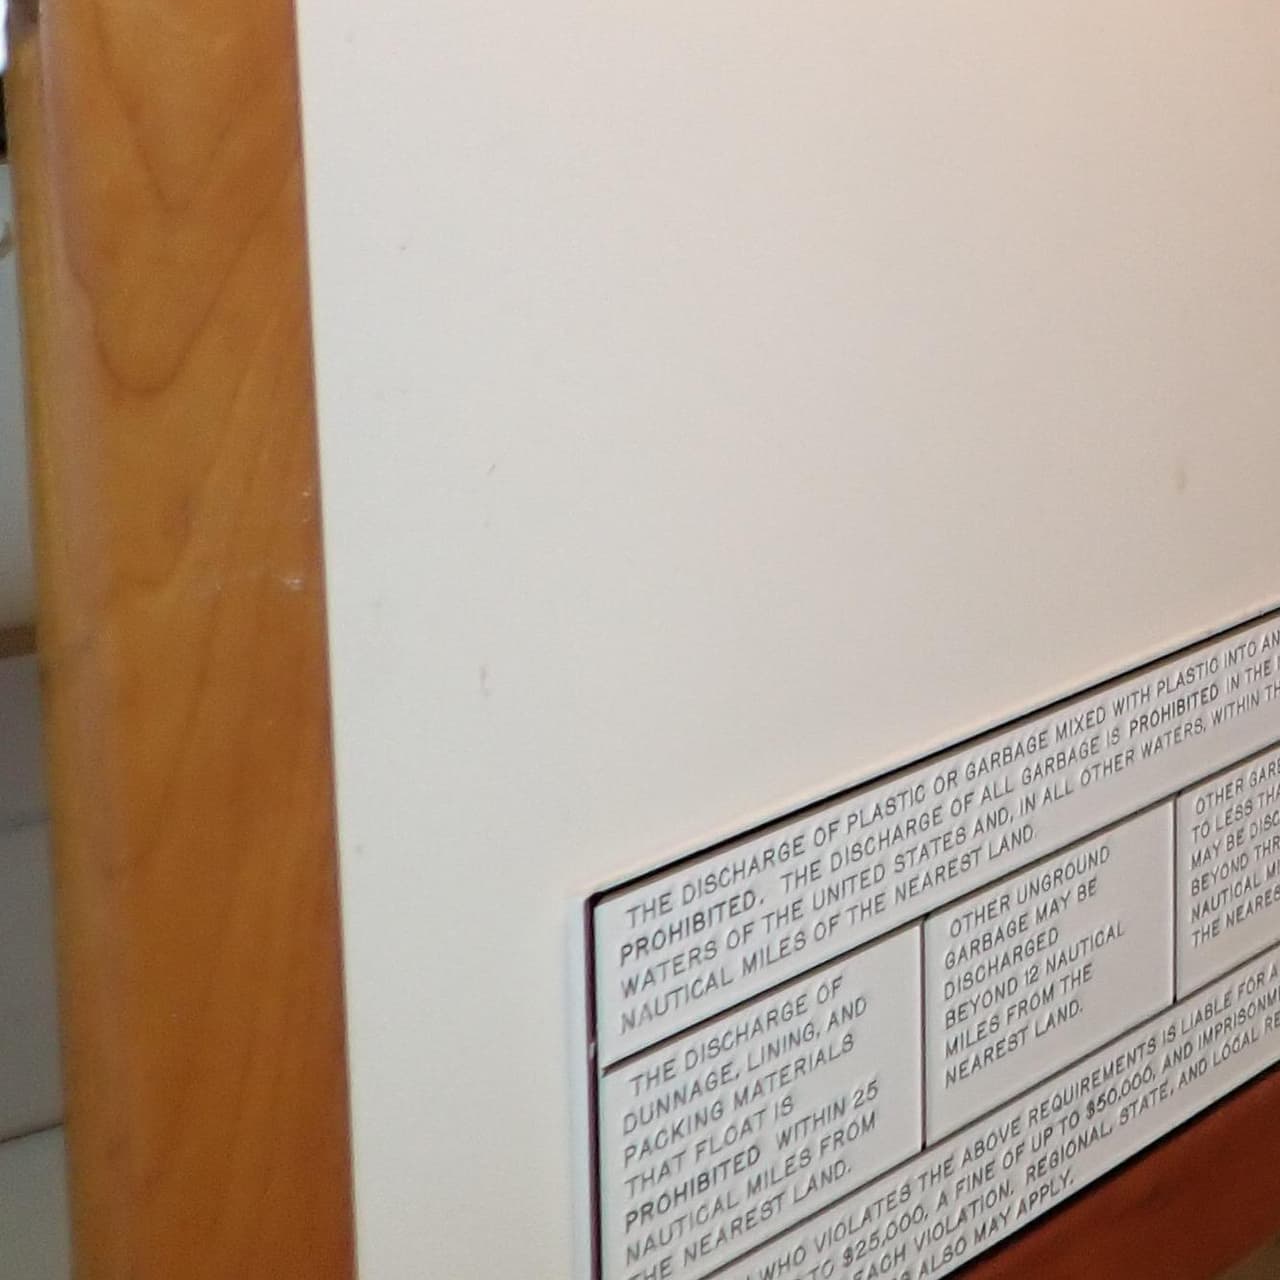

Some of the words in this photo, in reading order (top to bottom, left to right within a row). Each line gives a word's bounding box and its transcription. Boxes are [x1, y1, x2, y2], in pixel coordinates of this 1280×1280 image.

[779, 858, 822, 893] THE
[830, 803, 943, 873] DISCHARGE
[949, 789, 975, 817] OF
[980, 775, 1015, 806] ALL
[1021, 734, 1100, 786] GARBAGE
[1106, 725, 1120, 747] IS
[1129, 680, 1219, 738] PROHIBITED
[1226, 671, 1240, 693] IN
[1244, 657, 1271, 683] THE
[620, 938, 718, 999] WATERS
[725, 919, 755, 950] OF
[760, 896, 804, 934] THE
[812, 861, 886, 911] UNITED
[893, 824, 966, 874] STATES
[1019, 791, 1036, 816] IN
[1042, 779, 1074, 806] ALL
[1080, 747, 1135, 788] OTHER
[1212, 688, 1260, 727] WITHIN
[949, 893, 1010, 938] OTHER
[1016, 844, 1110, 905] UNGROUND
[1190, 851, 1249, 897] BEYOND
[621, 966, 734, 1034] NAUTICAL
[741, 928, 806, 977] MILES
[813, 911, 841, 942] OF
[845, 891, 886, 925] THE
[894, 844, 983, 904] NEAREST
[943, 925, 1059, 1001] DISCHARGED
[944, 975, 1018, 1030] BEYOND
[1024, 963, 1039, 986] 12
[1045, 920, 1125, 975] NAUTICAL
[628, 1057, 677, 1096] THE
[684, 992, 808, 1071] DISCHARGE
[816, 974, 843, 1005] OF
[1177, 1056, 1208, 1089] AND
[1212, 1026, 1259, 1067] LOCAL
[625, 1142, 761, 1234] PROHIBITED
[776, 1095, 846, 1151] WITHIN
[852, 1076, 879, 1110] 25
